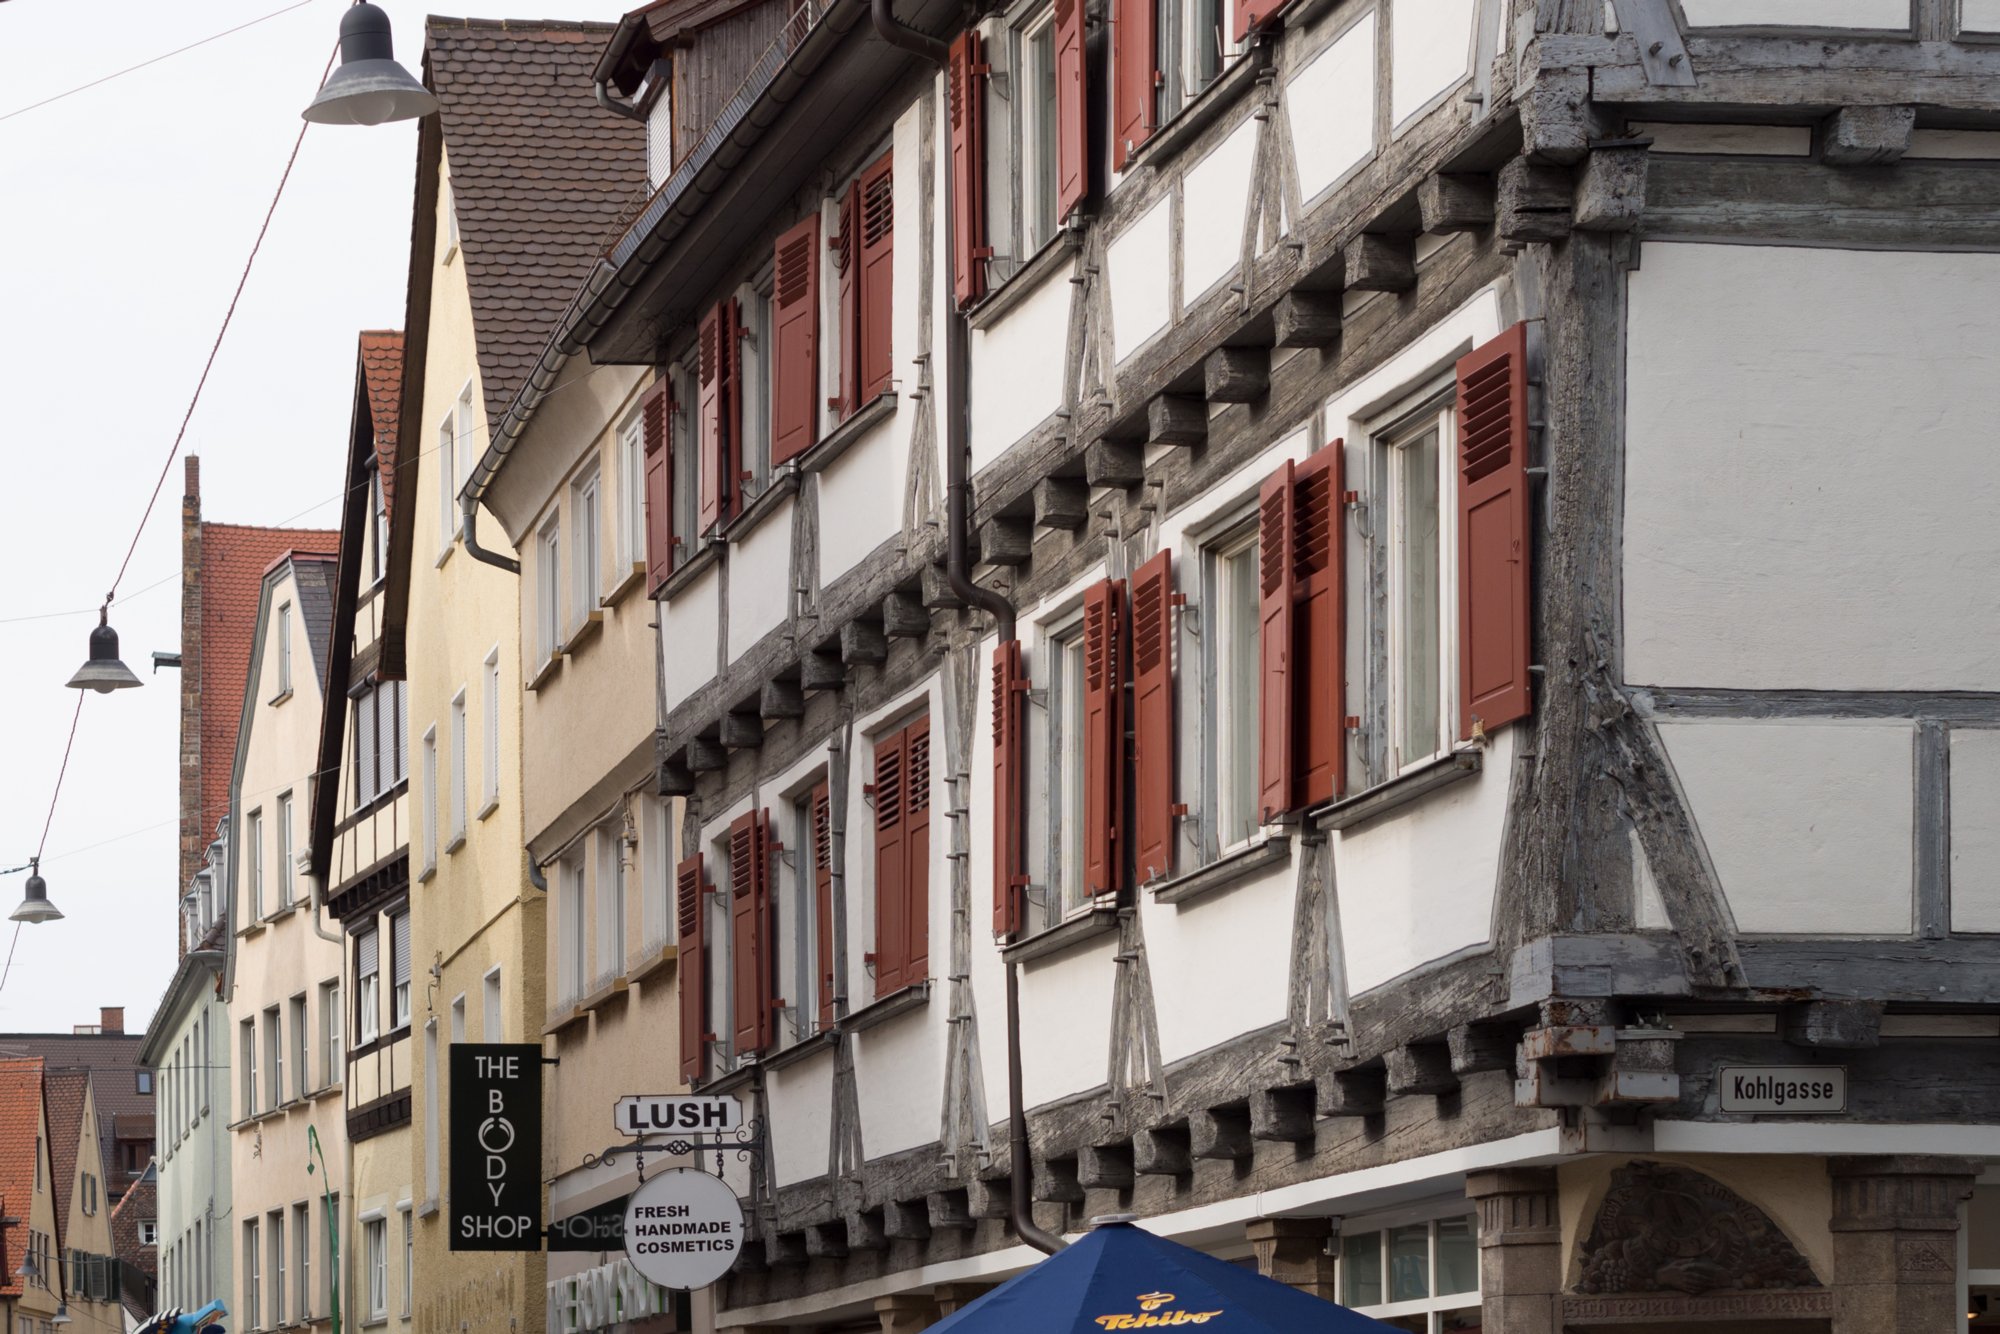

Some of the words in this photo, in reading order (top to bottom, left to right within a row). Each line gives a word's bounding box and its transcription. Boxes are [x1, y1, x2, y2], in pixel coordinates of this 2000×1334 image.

[475, 1056, 519, 1079] THE
[1734, 1076, 1833, 1106] Kohlgasse
[629, 1102, 728, 1129] LUSH
[478, 1089, 515, 1207] BODY
[634, 1205, 690, 1219] FRESH
[461, 1215, 532, 1239] SHOP
[635, 1221, 731, 1237] HANDMADE
[636, 1239, 735, 1254] COSMETICS
[1094, 1309, 1224, 1331] Tchibo
